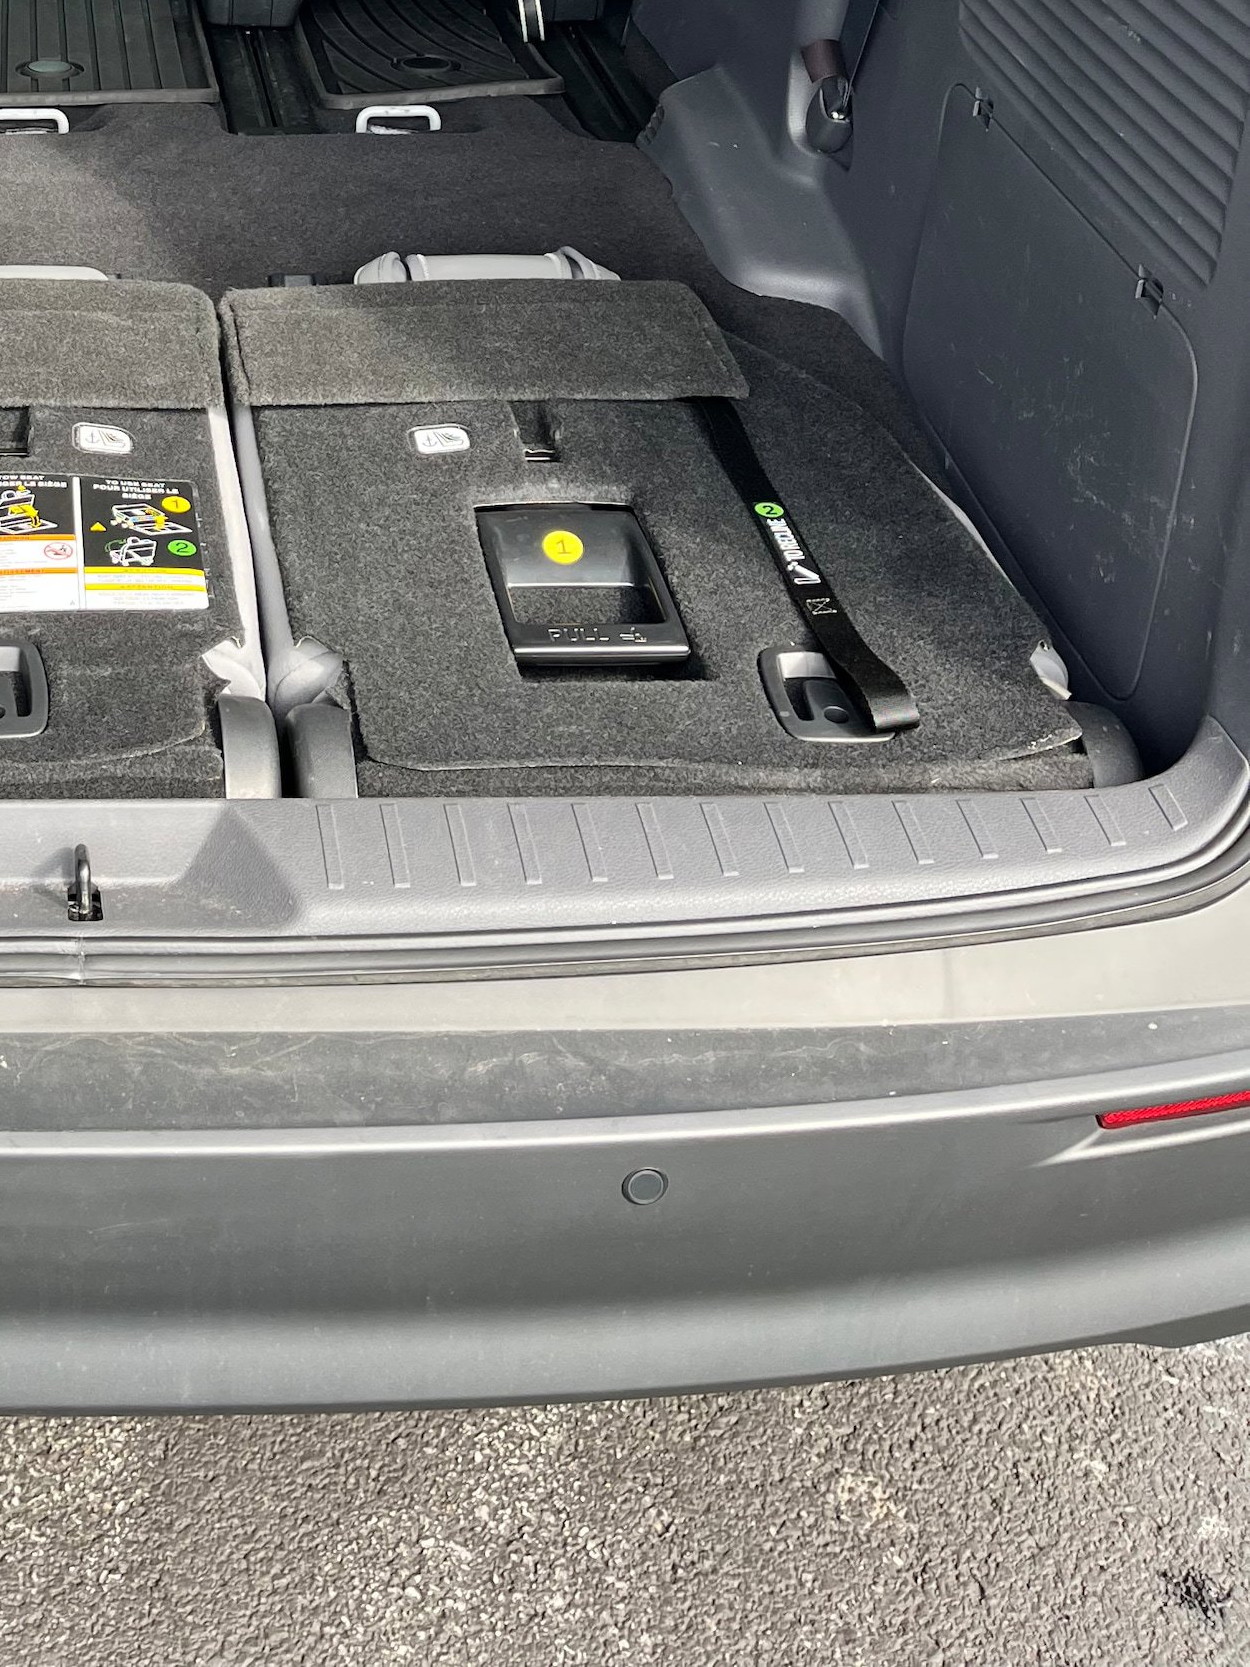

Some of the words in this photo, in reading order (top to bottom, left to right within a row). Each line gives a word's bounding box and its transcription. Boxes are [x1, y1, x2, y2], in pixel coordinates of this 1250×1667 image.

[23, 480, 37, 488] LE
[92, 483, 121, 492] POUR
[122, 485, 166, 494] UTILISER
[175, 542, 189, 553] 2
[556, 538, 571, 555] 1
[782, 549, 806, 562] TO
[547, 628, 610, 642] PULL
